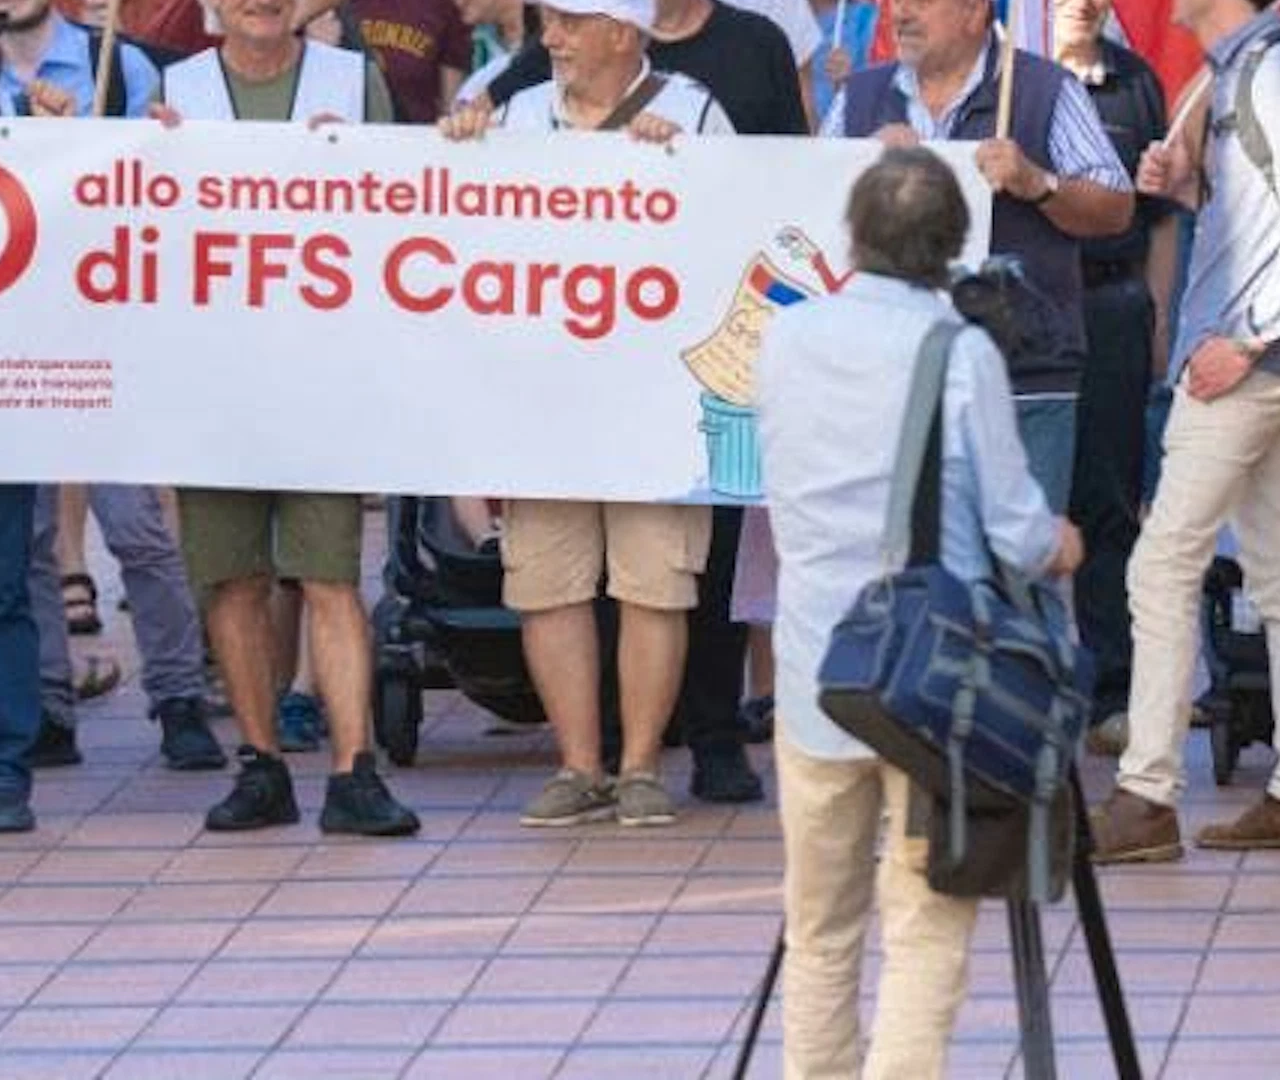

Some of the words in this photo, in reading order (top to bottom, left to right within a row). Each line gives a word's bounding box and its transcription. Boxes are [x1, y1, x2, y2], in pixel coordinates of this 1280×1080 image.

[75, 161, 180, 208] allo
[198, 168, 678, 224] smantellamento
[75, 226, 160, 304] di
[192, 231, 354, 311] FFS
[382, 236, 681, 340] Cargo
